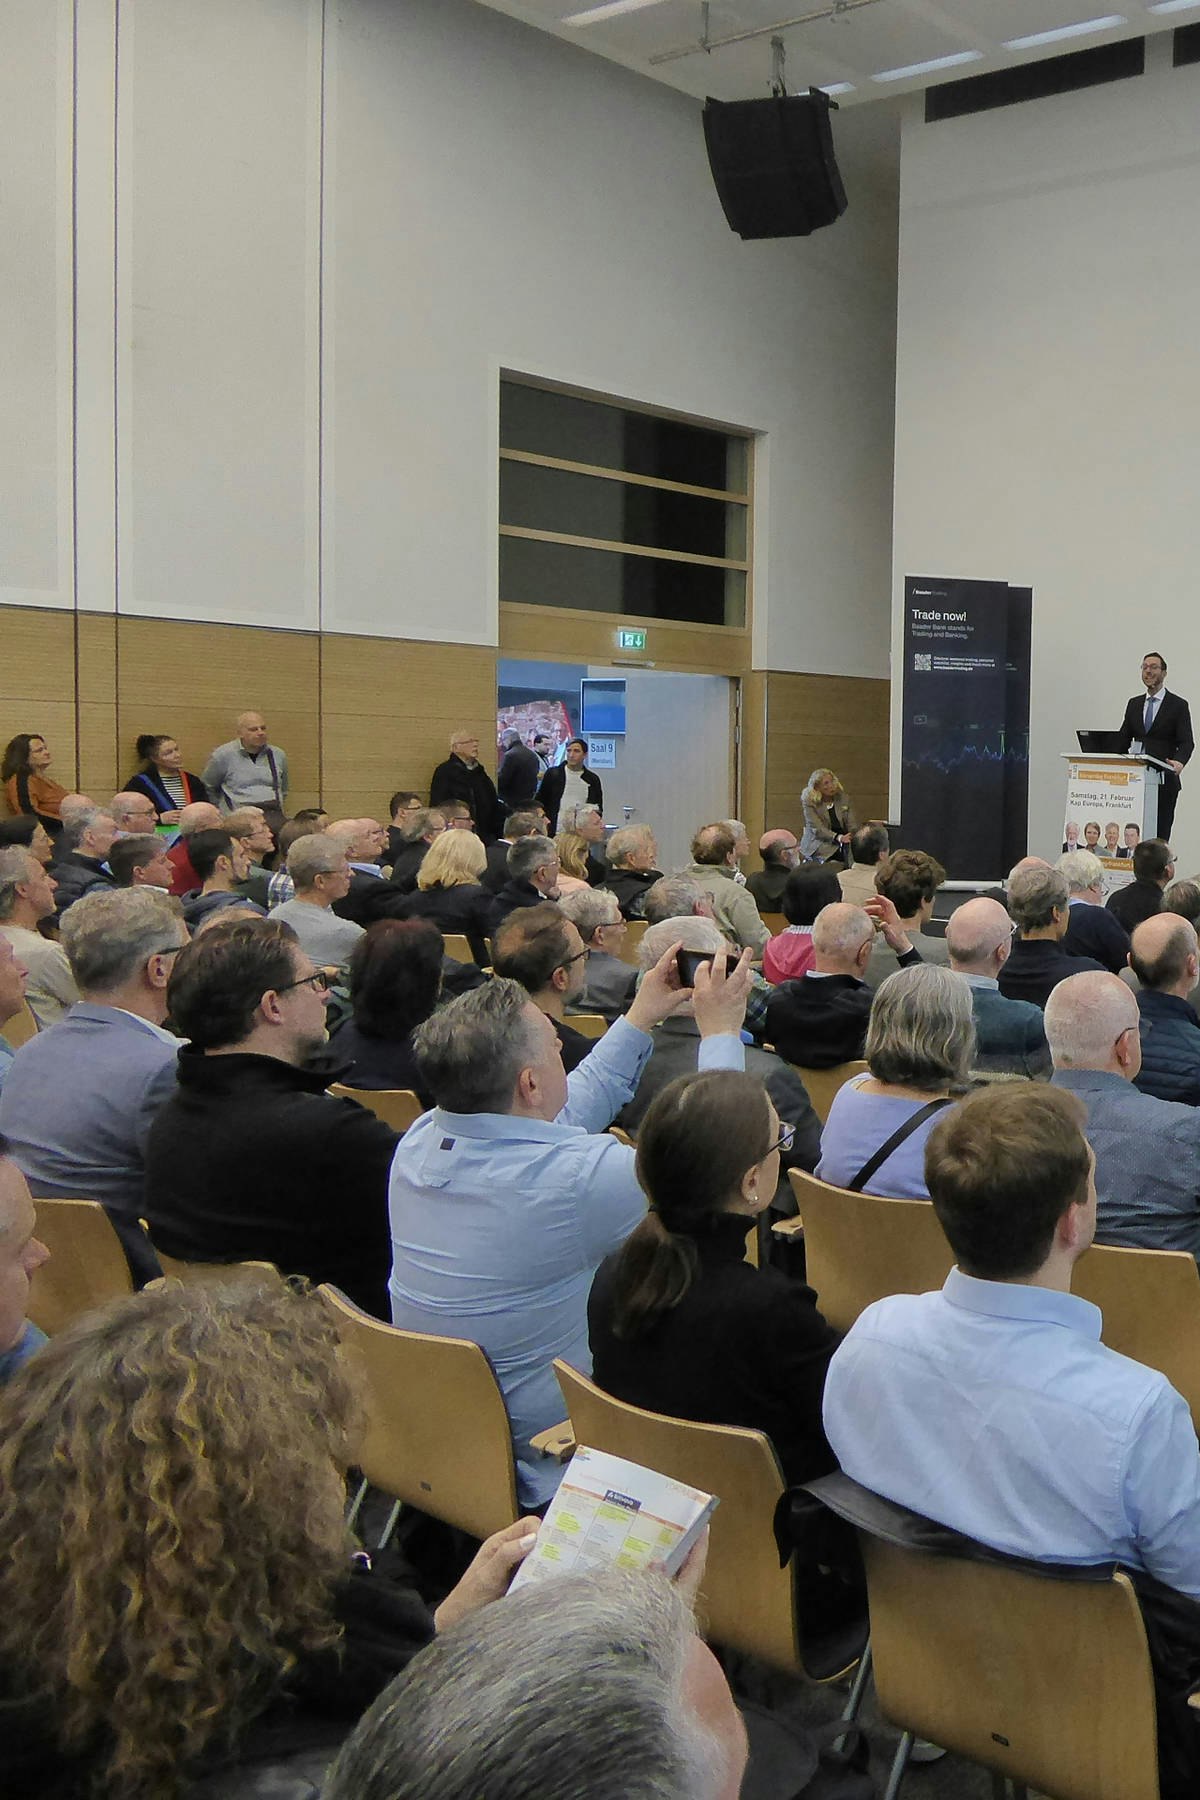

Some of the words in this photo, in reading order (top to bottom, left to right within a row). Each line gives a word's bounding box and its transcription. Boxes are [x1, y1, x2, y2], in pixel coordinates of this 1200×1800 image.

[912, 609, 941, 620] Trade
[943, 612, 966, 621] now!
[591, 743, 606, 752] Saal
[608, 743, 613, 752] 9
[1110, 793, 1135, 801] Februar
[1106, 801, 1132, 809] Frankfurt
